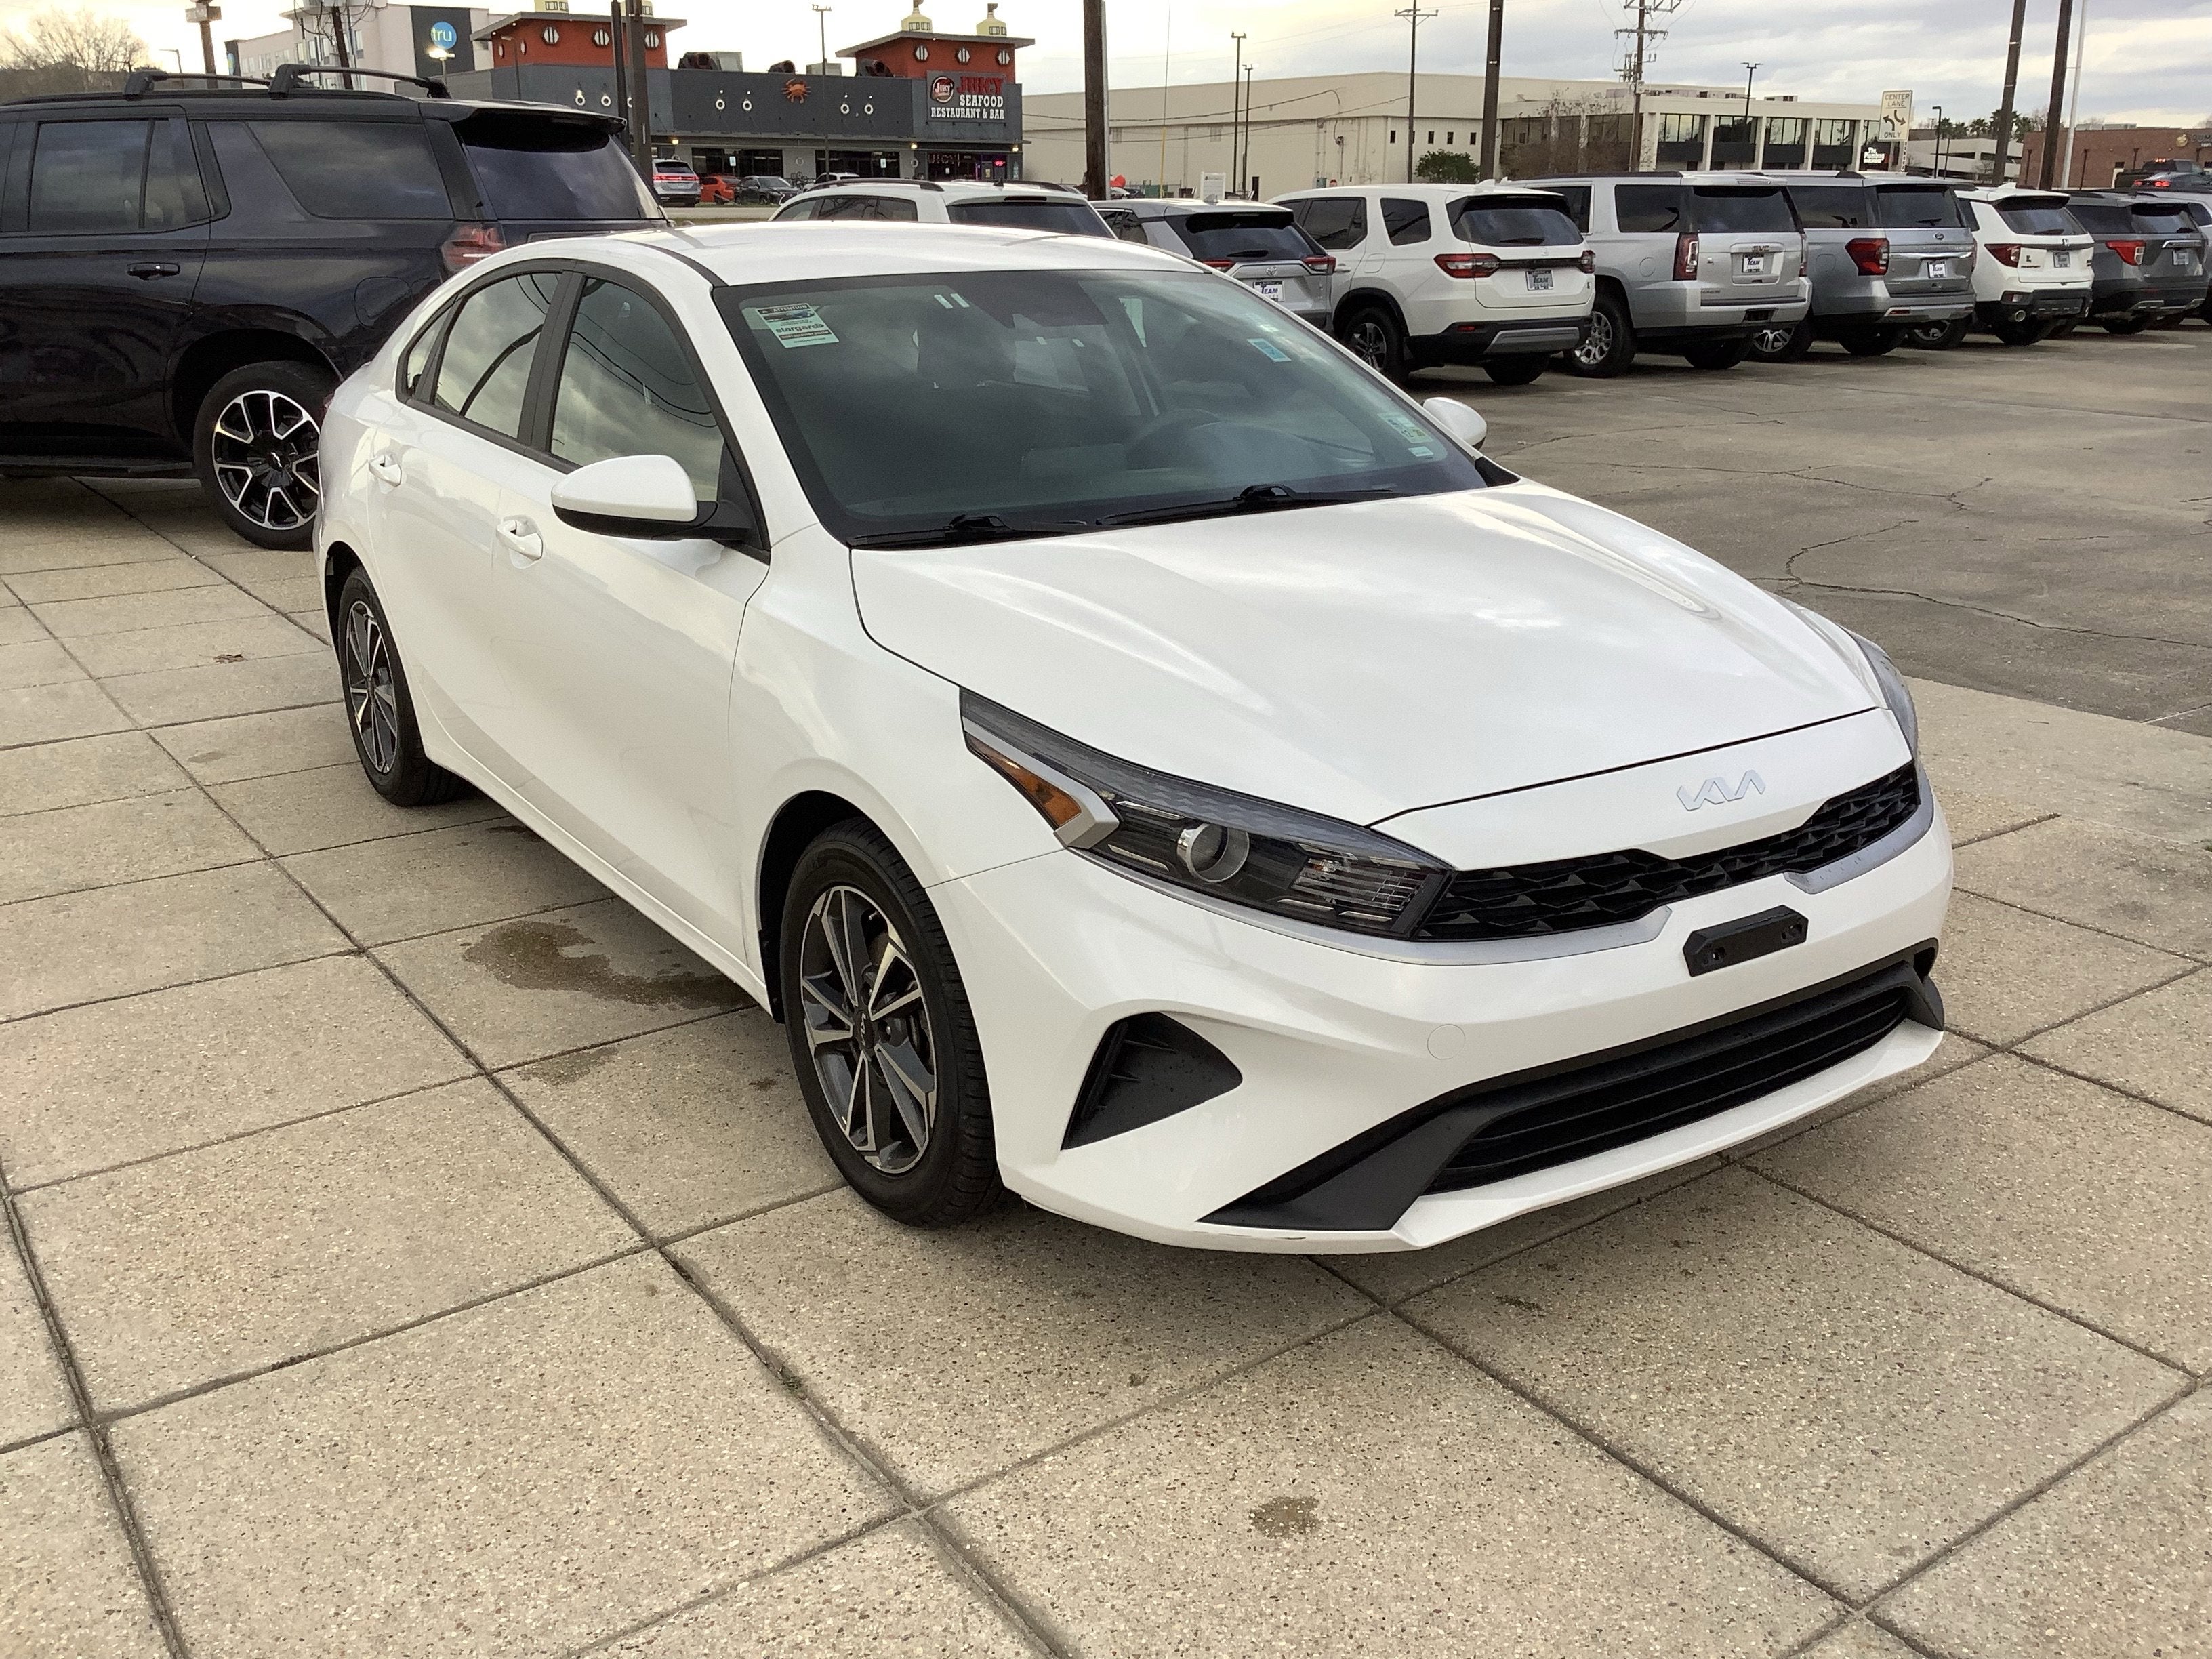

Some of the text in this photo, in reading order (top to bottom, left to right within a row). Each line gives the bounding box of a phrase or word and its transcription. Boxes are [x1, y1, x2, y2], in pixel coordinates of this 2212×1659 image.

[431, 27, 452, 41] tru
[956, 77, 1003, 94] JUICY
[960, 94, 1003, 107] SEAFOOD
[931, 107, 1004, 119] RESTAURANT & BAR
[1261, 284, 1278, 294] TEAM
